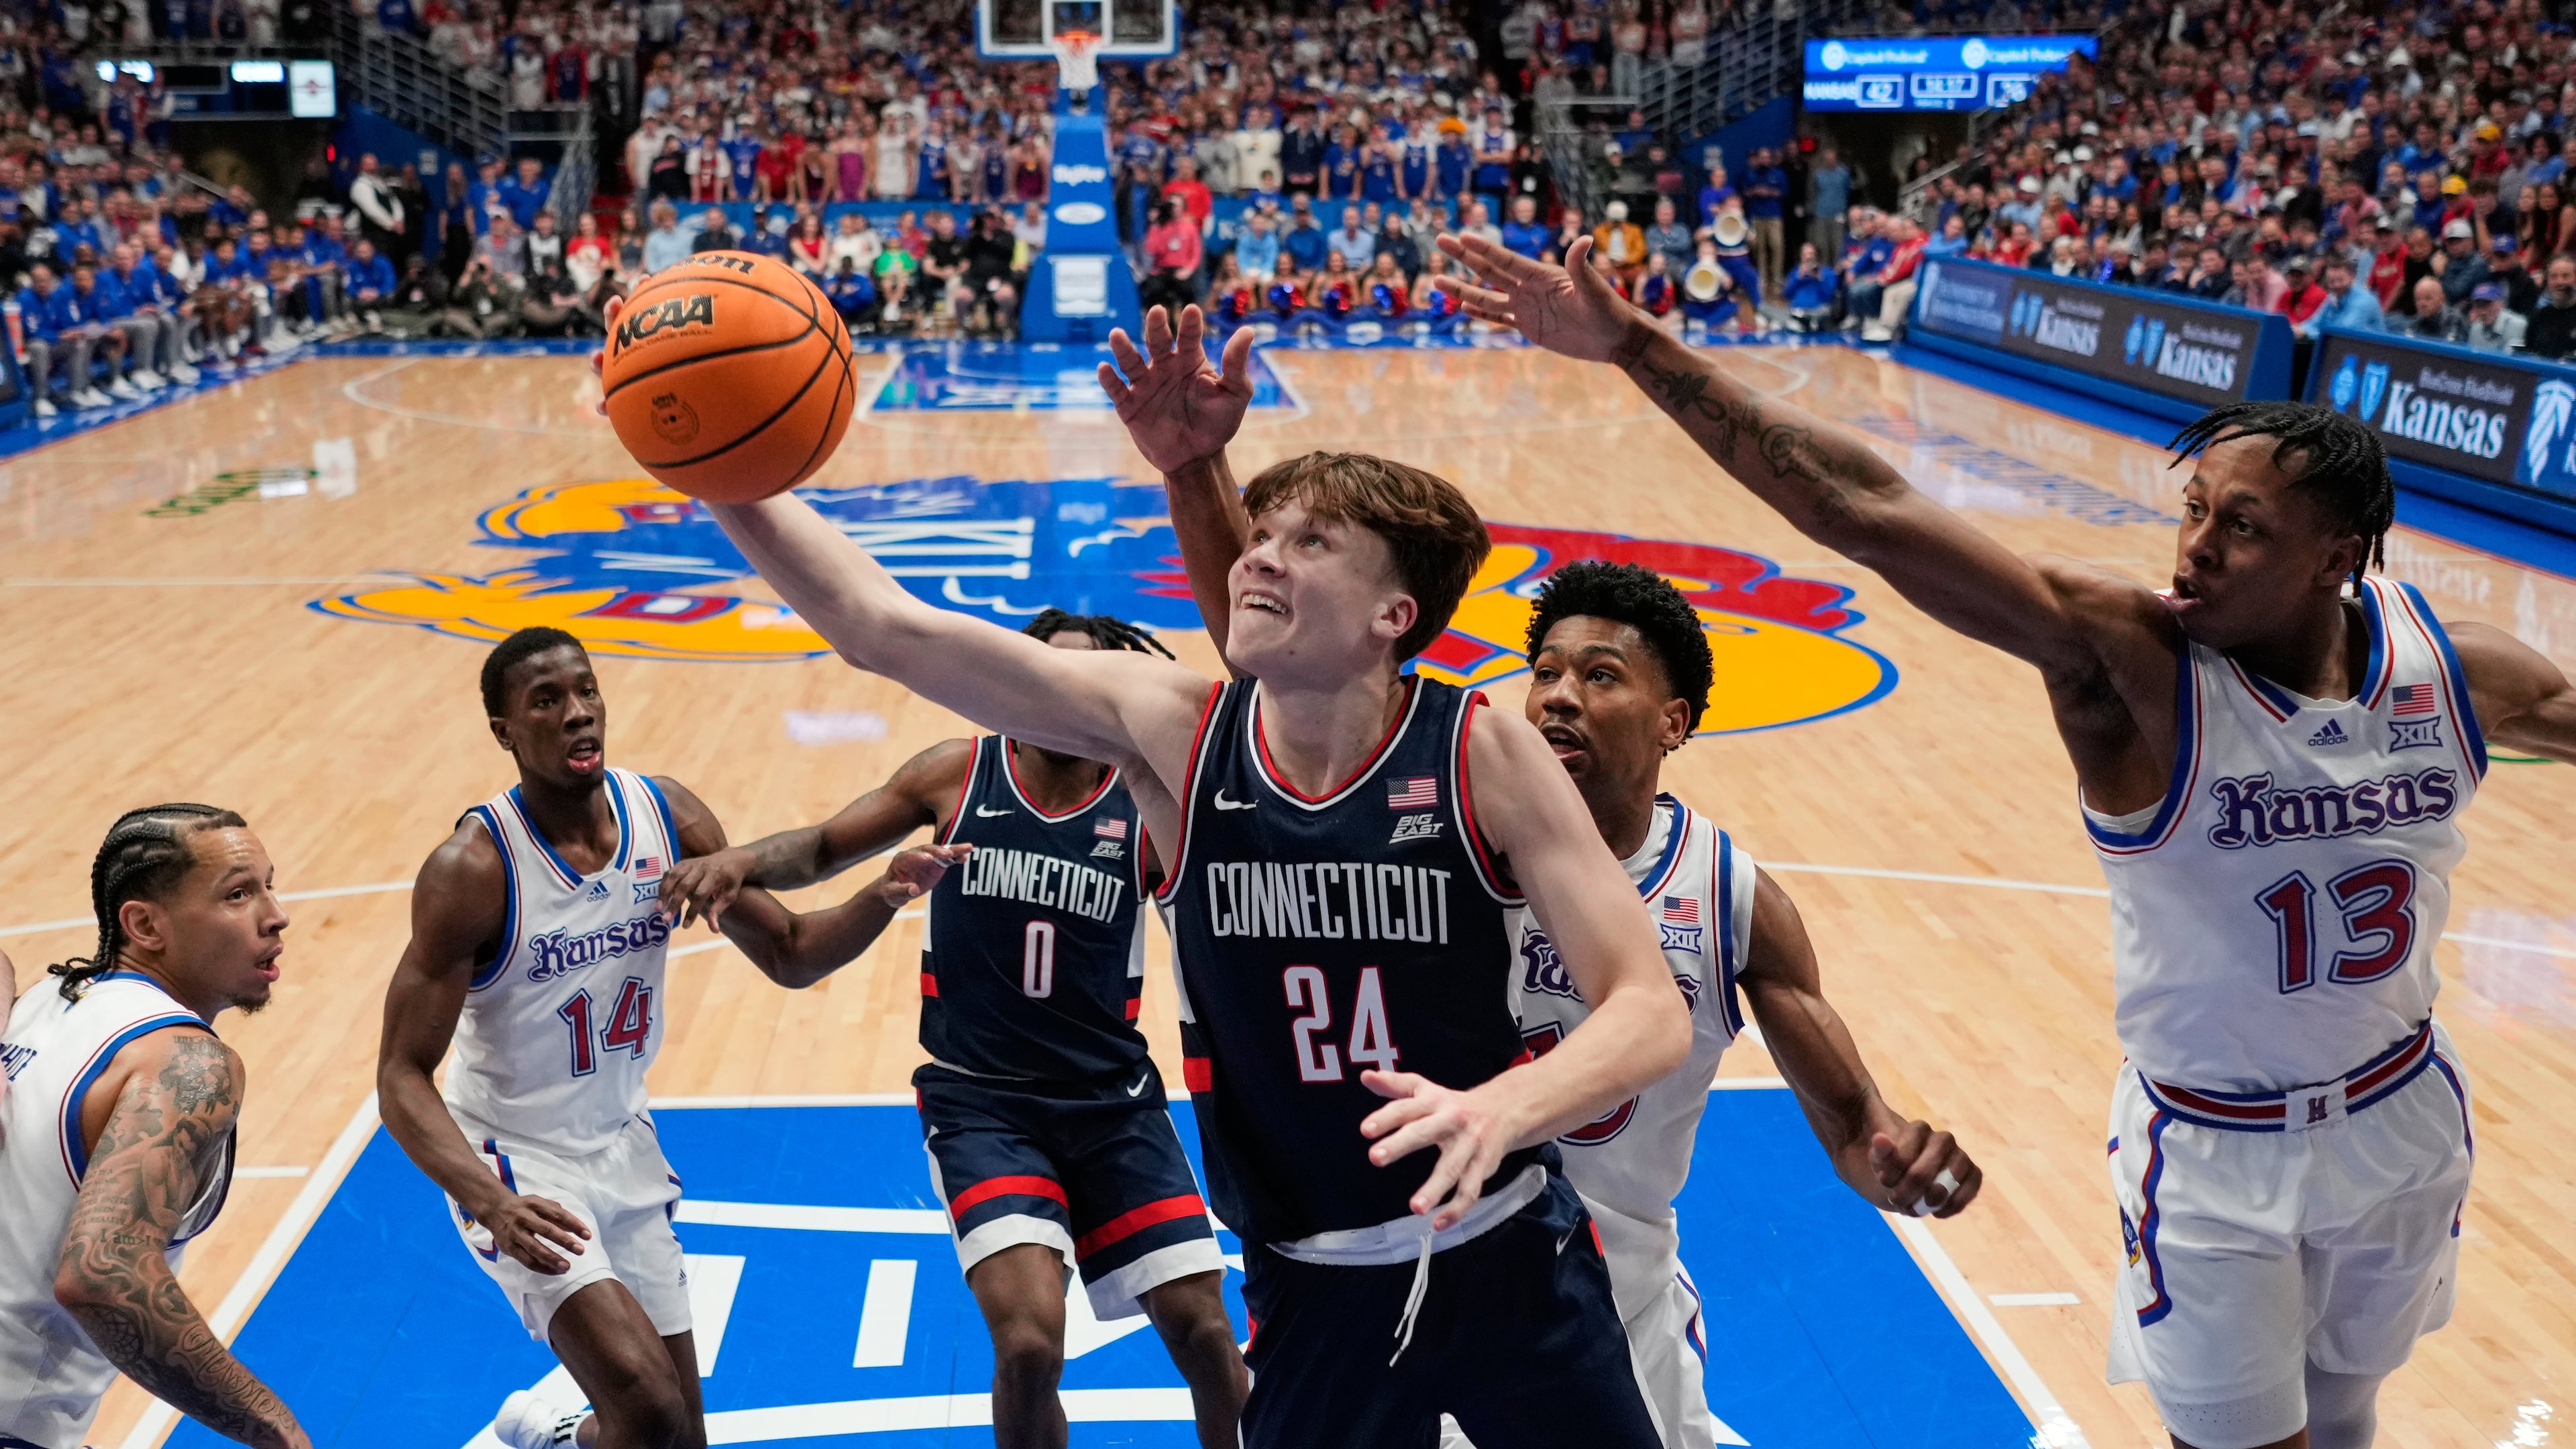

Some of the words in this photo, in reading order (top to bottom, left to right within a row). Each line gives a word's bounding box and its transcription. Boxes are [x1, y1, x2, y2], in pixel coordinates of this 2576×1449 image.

[613, 294, 715, 358] NCAA
[2035, 304, 2100, 357] Kansas
[2157, 331, 2238, 391] Kansas
[2381, 380, 2508, 459] Kansas
[2308, 735, 2348, 747] adidas
[1392, 822, 1444, 838] EAST
[1397, 813, 1434, 827] BIG
[2208, 766, 2458, 850] Kansas
[1093, 847, 1126, 857] EAST
[1097, 840, 1122, 851] BIG
[961, 847, 1125, 924] CONNECTICUT
[1207, 861, 1452, 945] CONNECTICUT
[528, 912, 670, 981] Kansas
[1023, 920, 1055, 999] 0
[2254, 859, 2416, 994] 13
[557, 977, 653, 1077] 14
[1281, 963, 1402, 1084] 24
